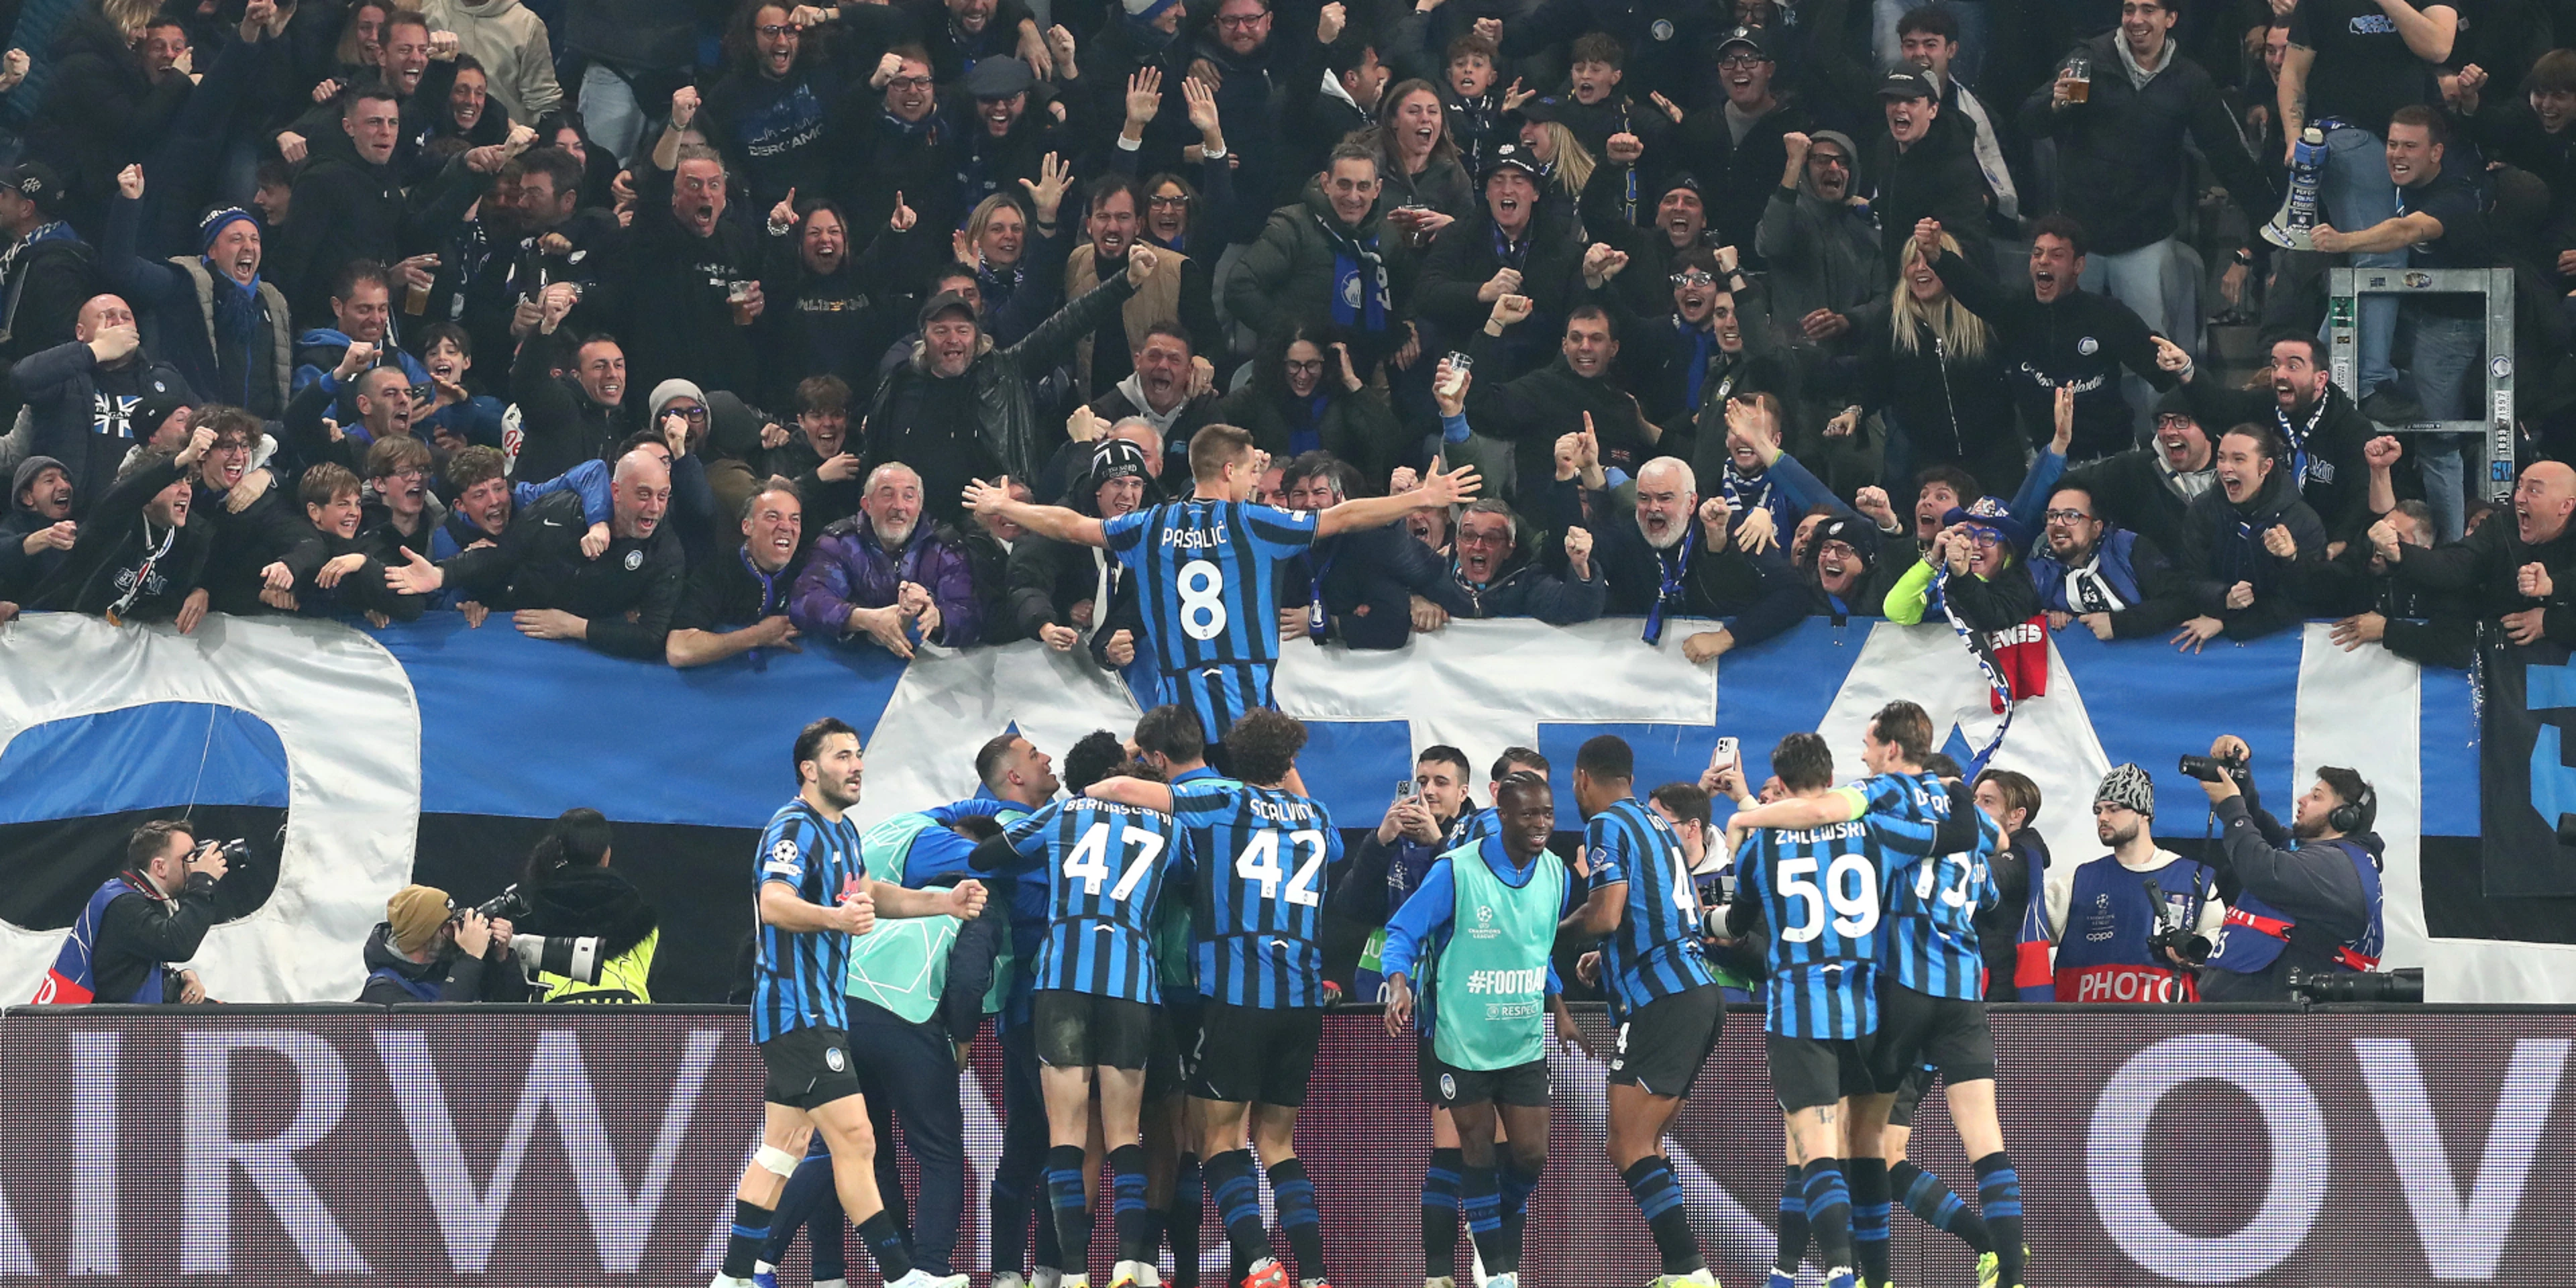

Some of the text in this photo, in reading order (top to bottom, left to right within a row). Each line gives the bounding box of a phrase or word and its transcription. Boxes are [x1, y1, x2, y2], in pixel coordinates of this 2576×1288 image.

[1161, 520, 1227, 549] PAŠALIĆ
[1177, 559, 1227, 641] 8
[1249, 798, 1316, 822] SCALVINI
[1063, 822, 1165, 902] 47
[1235, 827, 1327, 908] 42
[1672, 846, 1699, 925] 4
[1776, 853, 1880, 943] 59
[2078, 971, 2184, 1004] PHOTO
[1617, 1022, 1631, 1054] 4
